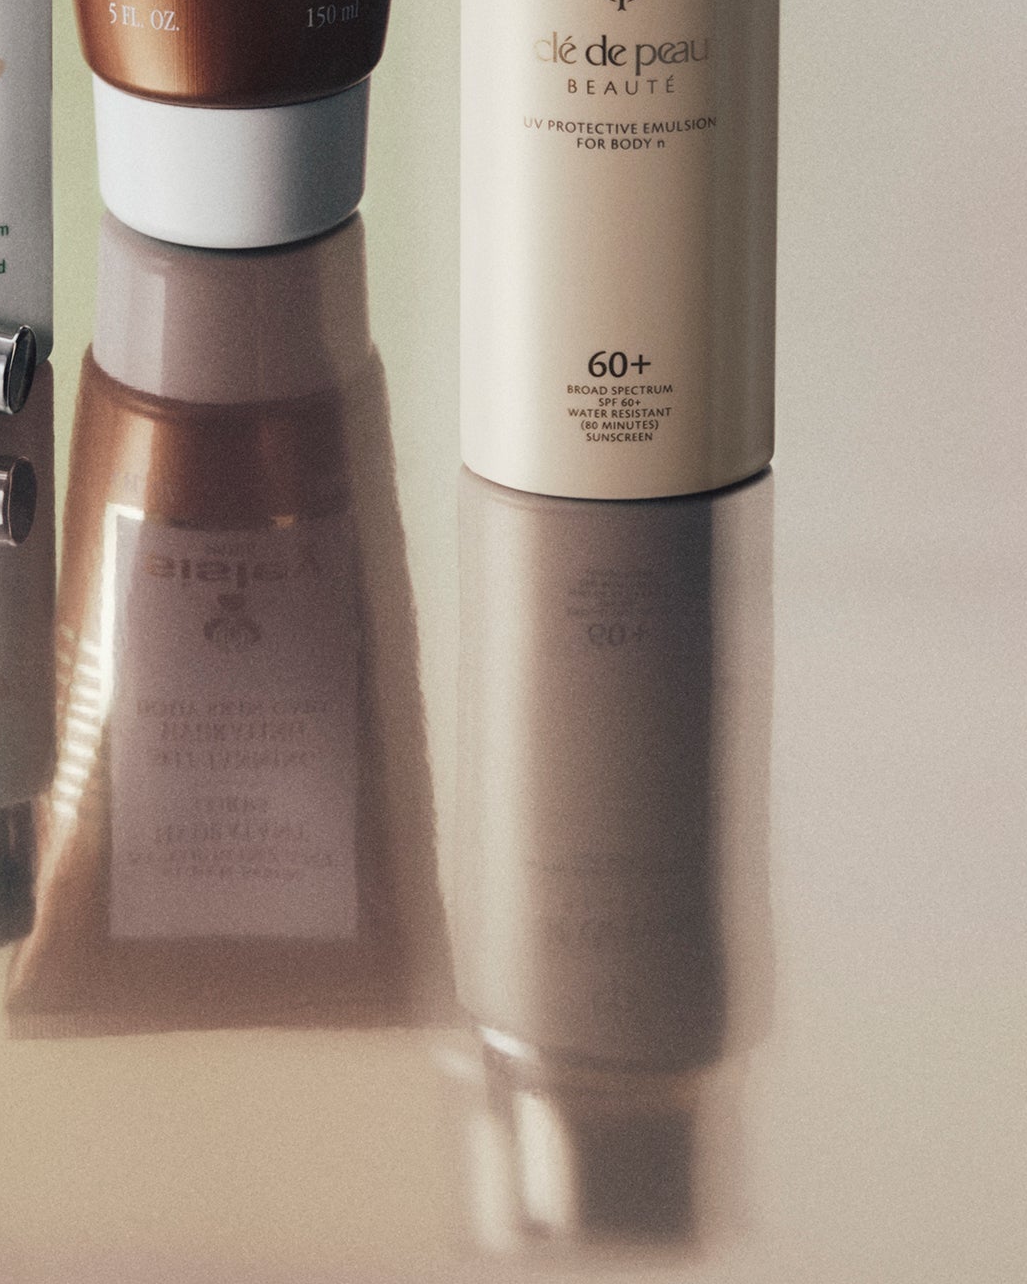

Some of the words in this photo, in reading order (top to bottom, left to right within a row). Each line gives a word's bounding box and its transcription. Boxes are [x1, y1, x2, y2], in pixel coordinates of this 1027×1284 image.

[108, 2, 117, 24] 5
[150, 9, 180, 32] OZ.
[307, 3, 336, 28] 150
[532, 31, 577, 66] clé
[585, 34, 627, 66] de
[635, 36, 711, 76] peau
[567, 75, 675, 96] BEAUTÉ
[523, 116, 543, 130] UV
[547, 119, 638, 135] PROTECTIVE
[643, 116, 717, 135] EMULSION
[576, 137, 606, 150] FOR
[610, 137, 652, 150] BODY
[587, 350, 652, 378] 60+
[566, 384, 608, 396] BROAD
[611, 384, 674, 396] SPECTRUM
[598, 397, 617, 408] SPF
[621, 397, 641, 408] 60+
[568, 407, 608, 419] WATER
[611, 406, 673, 419] RESISTANT
[580, 420, 598, 431] (80
[601, 419, 660, 431] MINUTES)
[585, 432, 653, 443] SUNSCREEN
